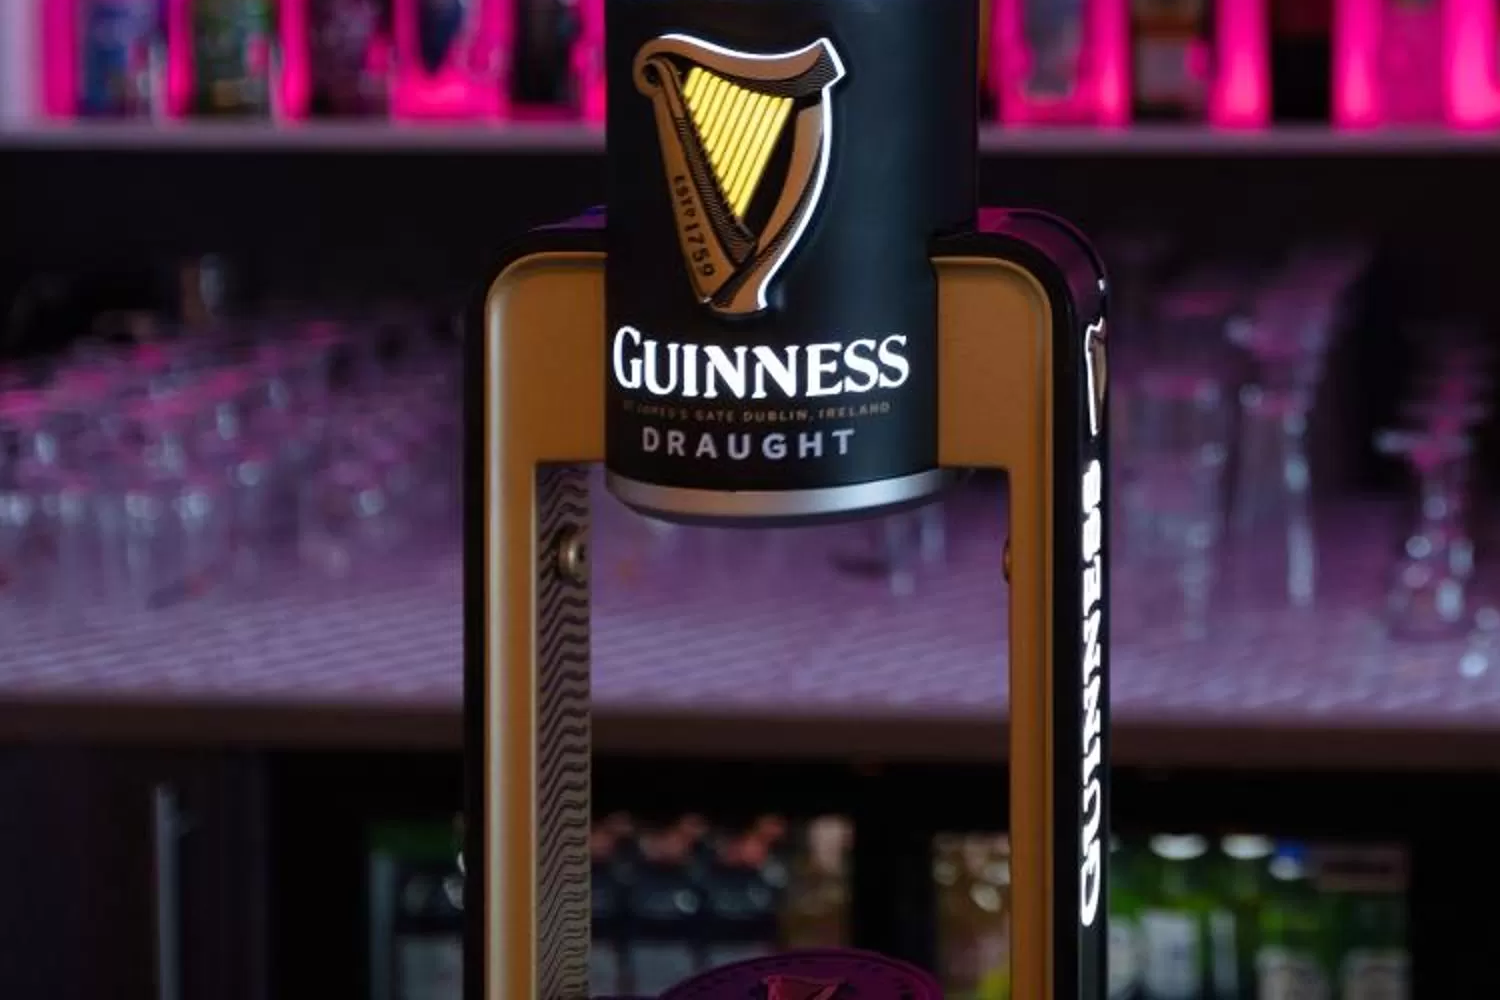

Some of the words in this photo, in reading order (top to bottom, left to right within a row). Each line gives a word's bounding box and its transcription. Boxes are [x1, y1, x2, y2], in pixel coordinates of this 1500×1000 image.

[684, 222, 716, 277] 1759
[613, 325, 910, 399] GUINNESS
[818, 401, 891, 420] IRELAND
[642, 425, 856, 460] DRAUGHT
[1080, 458, 1102, 927] GUINNESS
